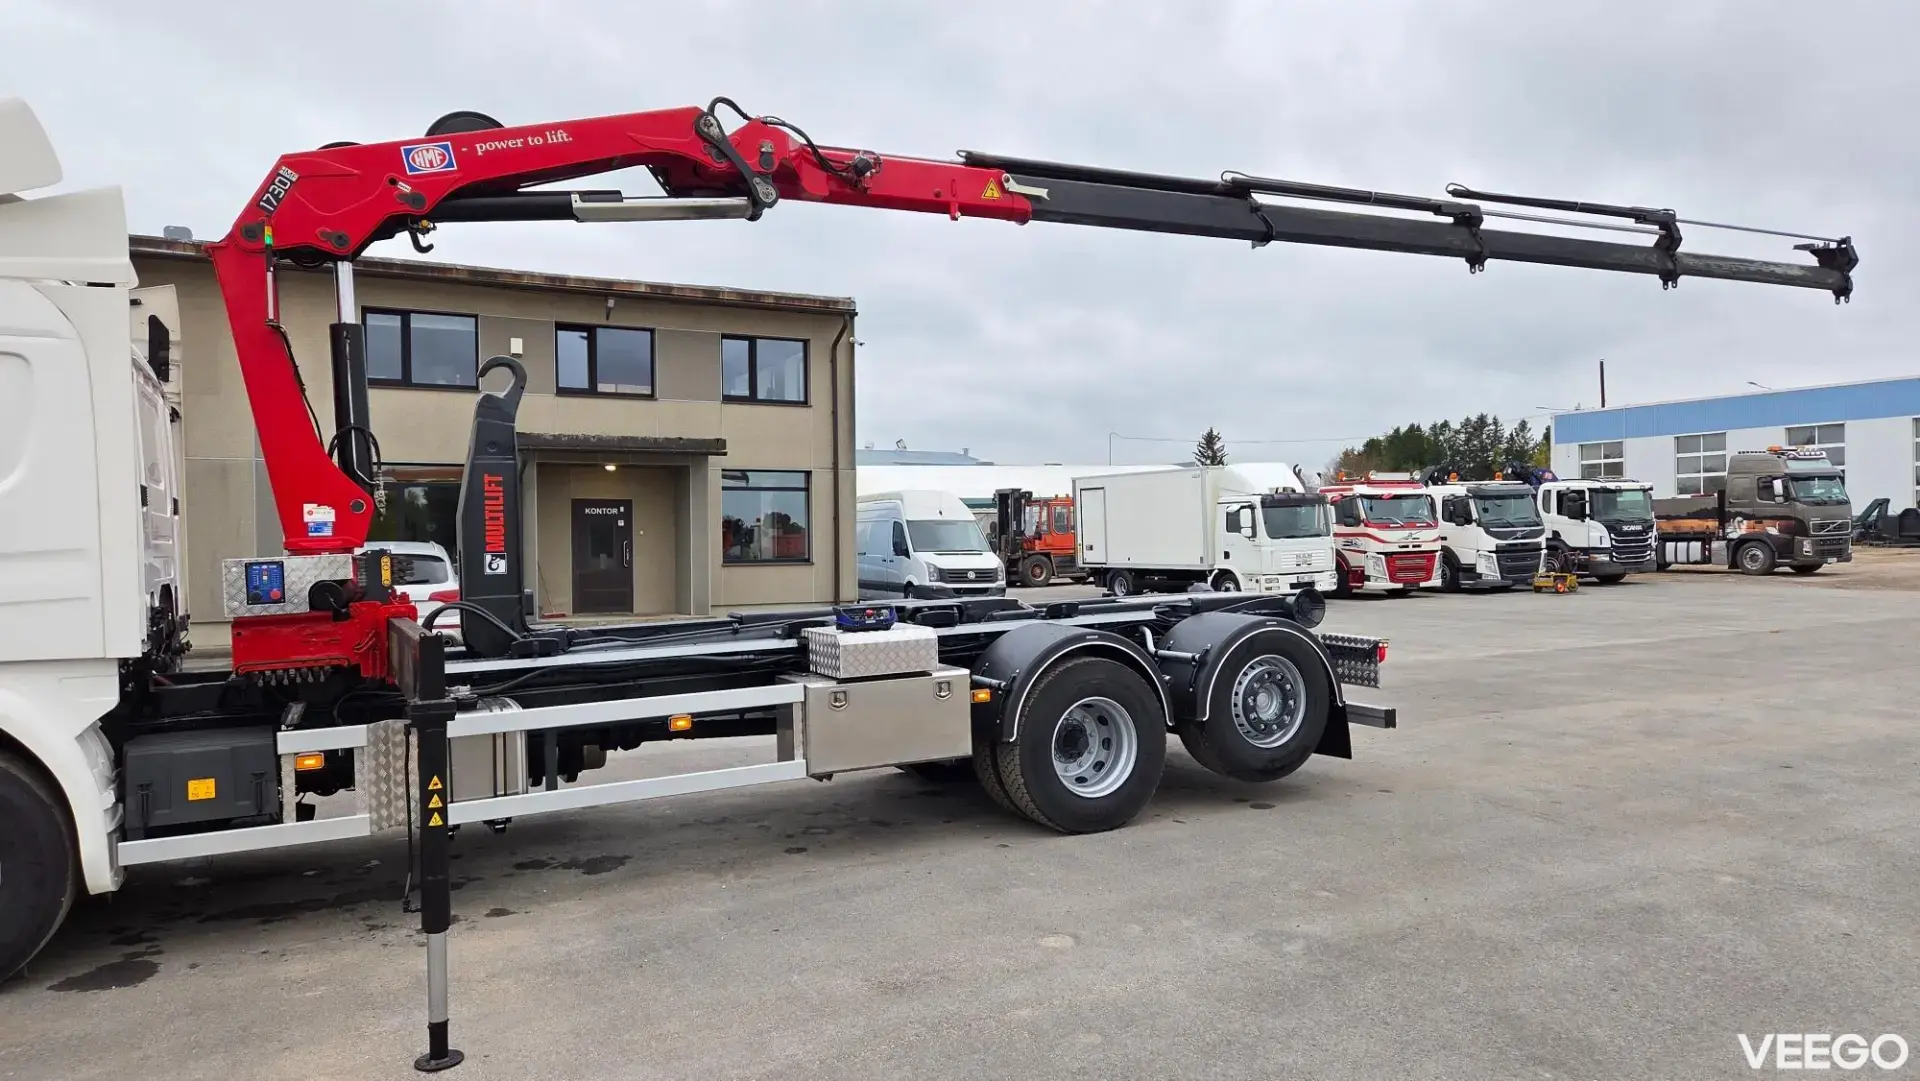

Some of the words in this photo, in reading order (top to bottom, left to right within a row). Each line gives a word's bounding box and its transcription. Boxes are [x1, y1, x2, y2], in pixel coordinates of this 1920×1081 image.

[475, 137, 524, 156] power
[527, 134, 543, 146] to
[546, 129, 573, 144] lift.
[414, 148, 443, 169] HMF
[260, 176, 290, 211] 1730
[484, 473, 505, 552] MULTILIFT
[585, 507, 618, 515] KONTOR
